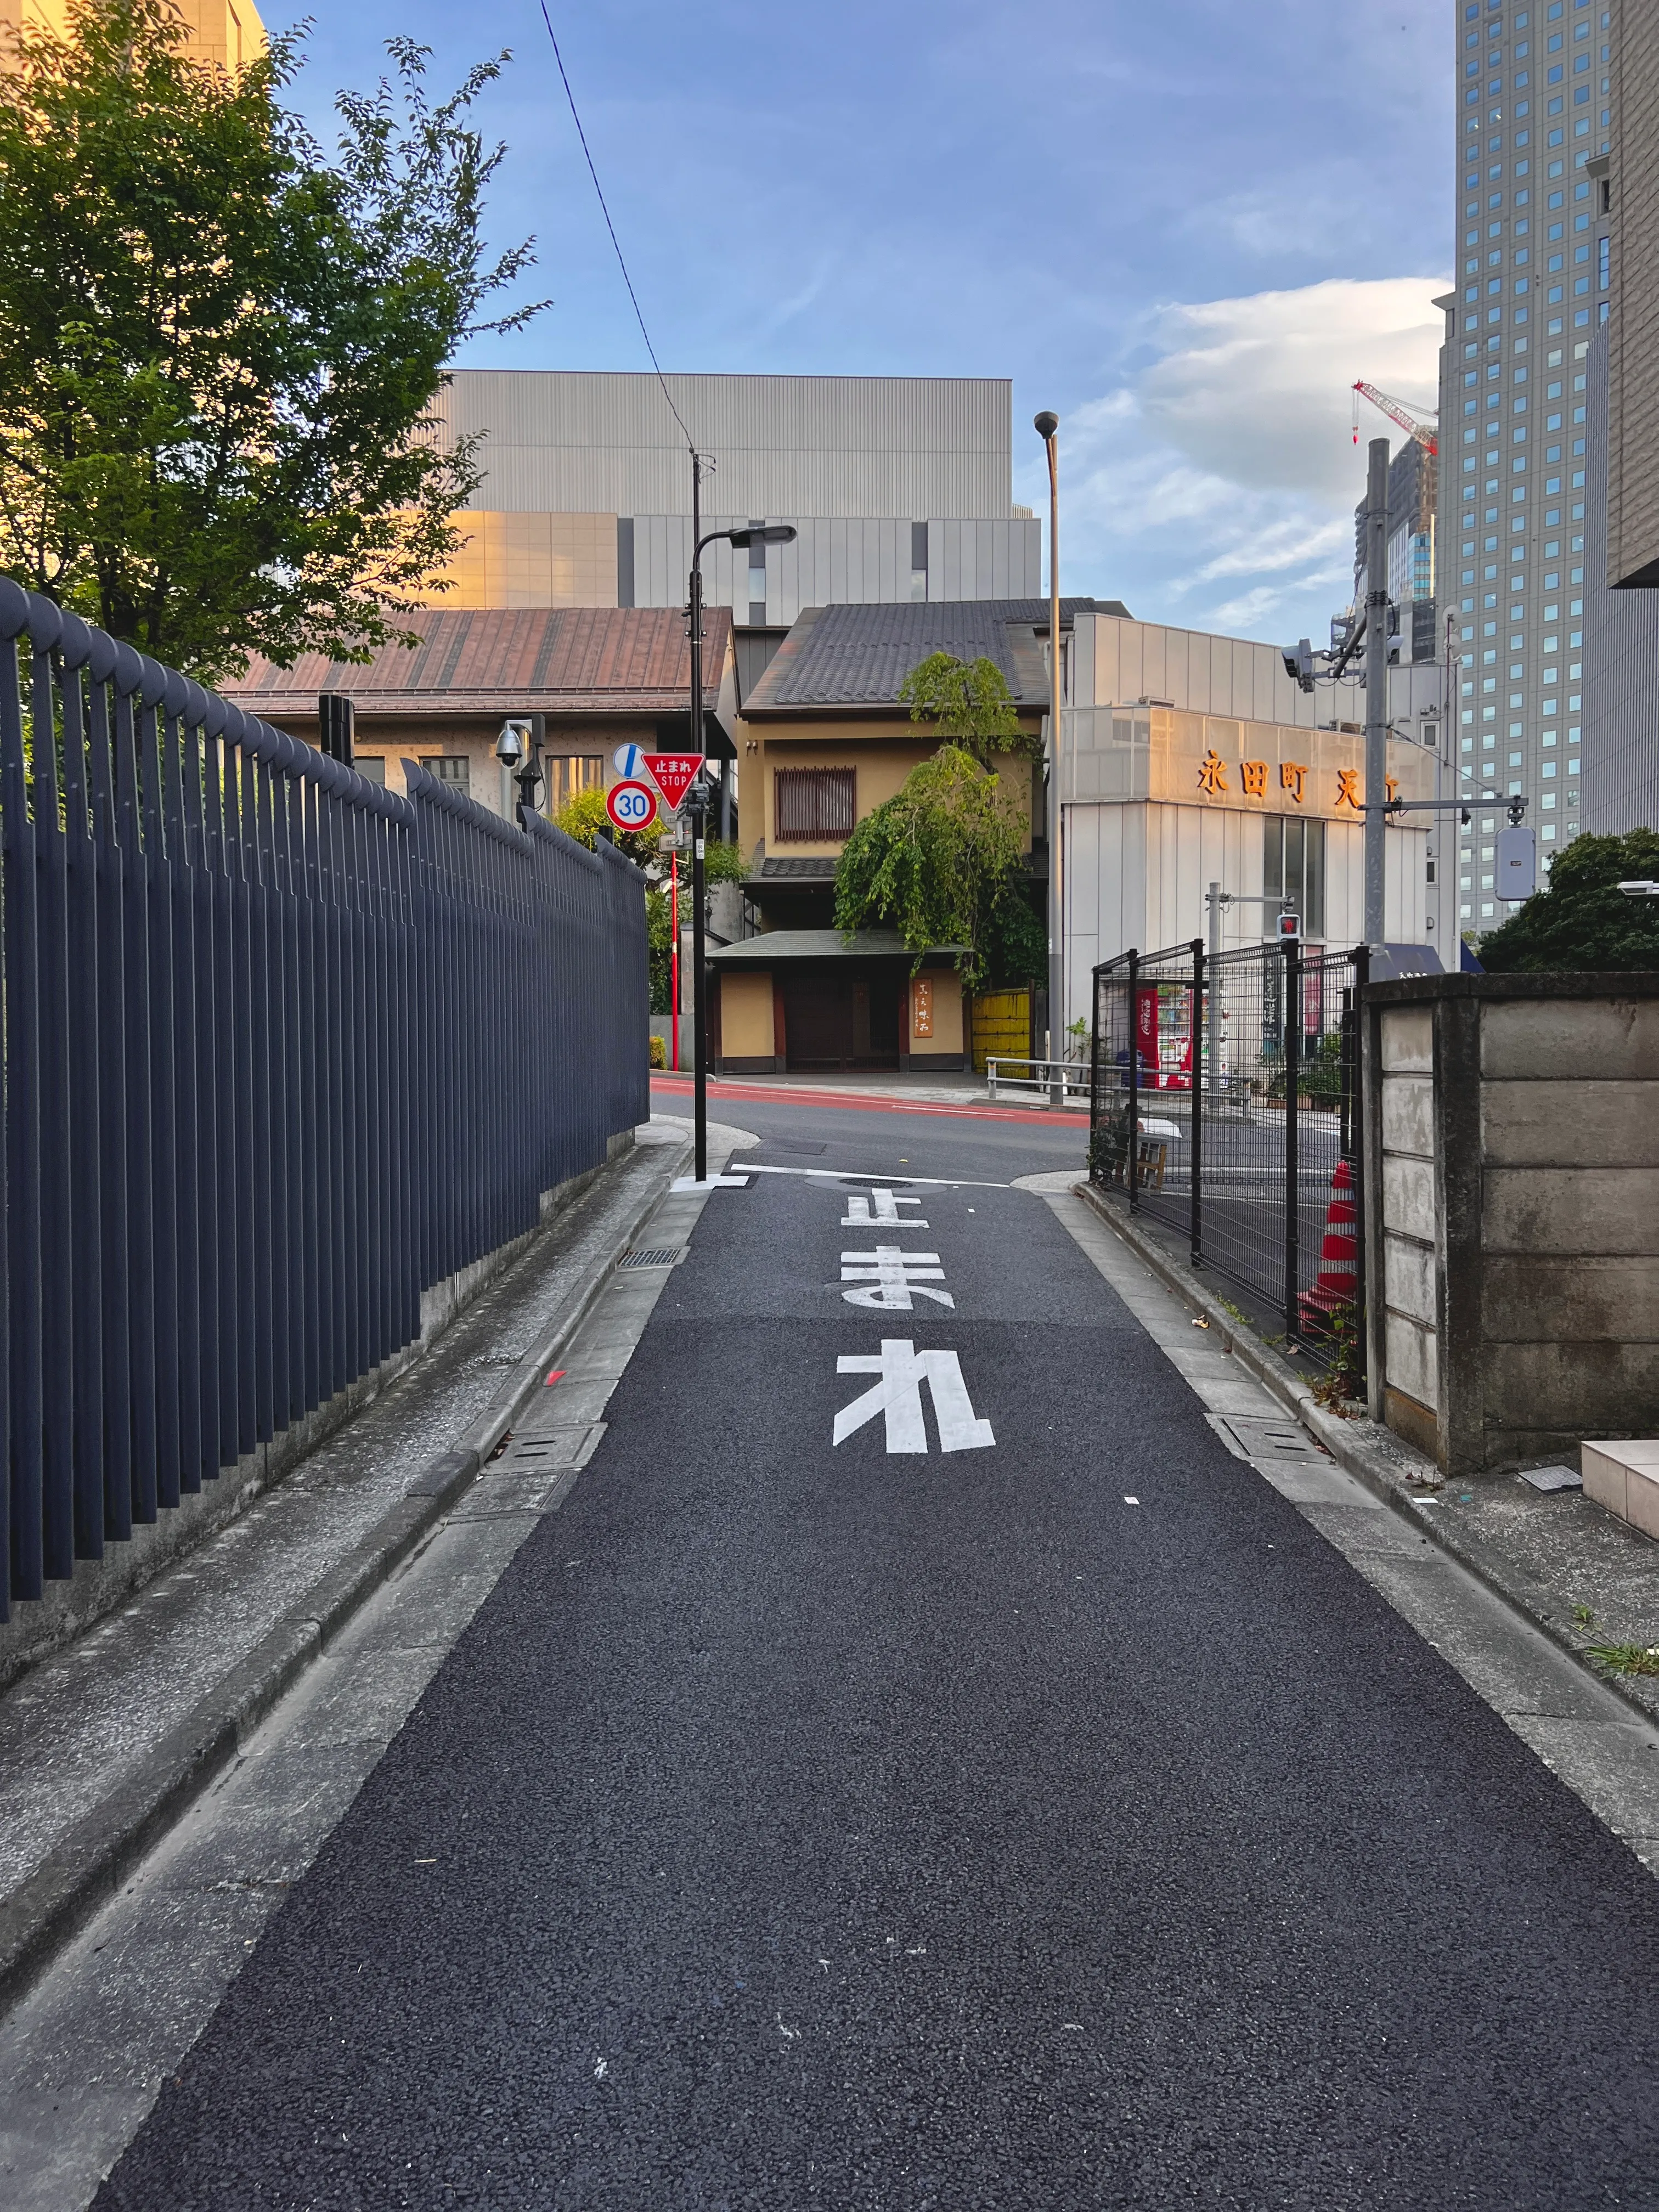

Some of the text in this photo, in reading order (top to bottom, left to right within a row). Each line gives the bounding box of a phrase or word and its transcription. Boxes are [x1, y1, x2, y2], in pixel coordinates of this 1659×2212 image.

[655, 760, 692, 773] 止まれ
[662, 776, 687, 786] STOP
[619, 795, 646, 817] 30
[832, 1188, 996, 1453] 止まれ
